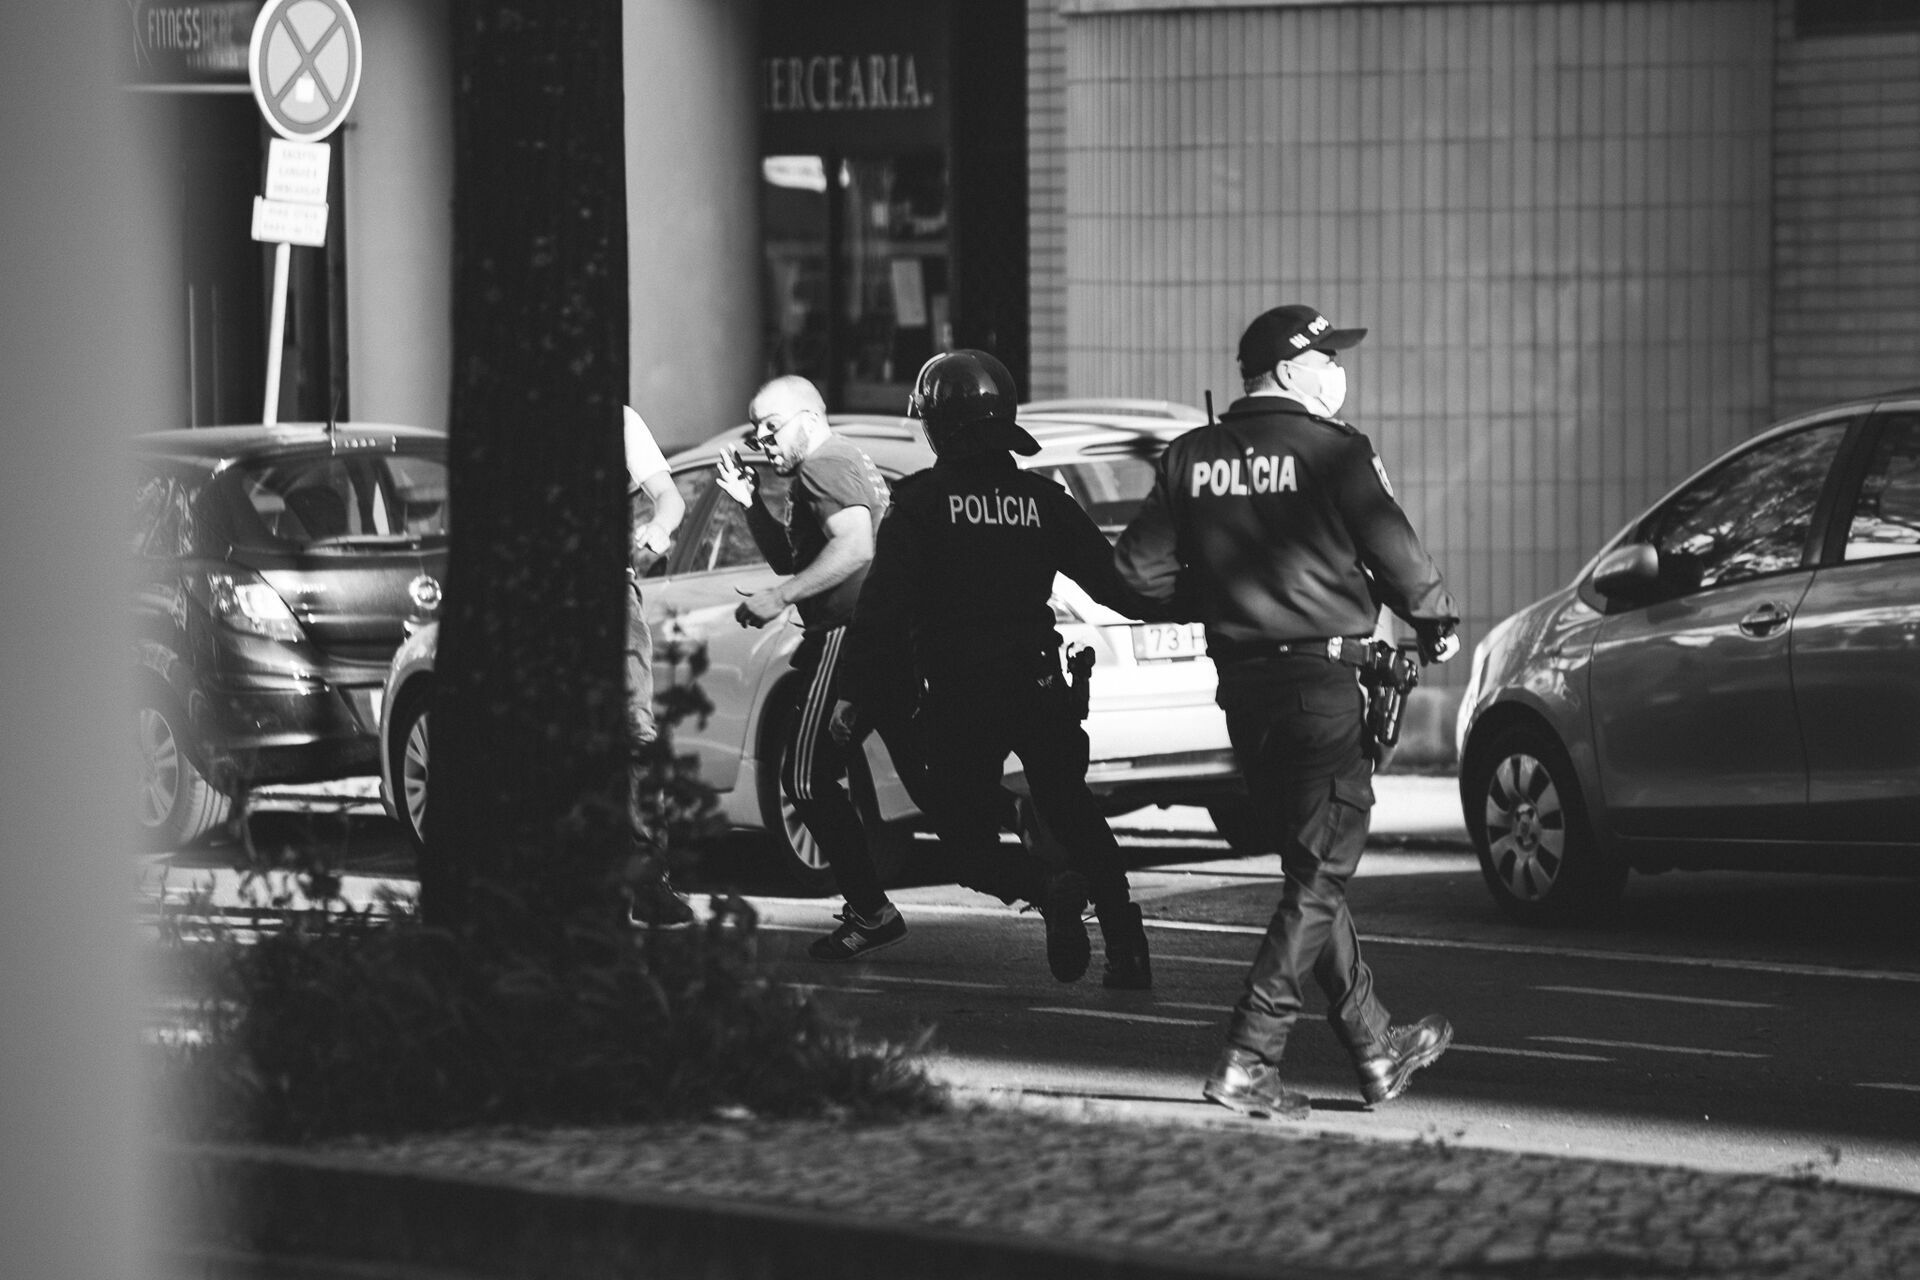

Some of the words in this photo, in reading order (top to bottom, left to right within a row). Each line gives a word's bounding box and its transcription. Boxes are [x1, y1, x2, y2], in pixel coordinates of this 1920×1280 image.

[763, 53, 935, 111] ERCEARIA.
[1191, 446, 1298, 498] POLÍCIA
[948, 488, 1041, 528] POLÍCIA
